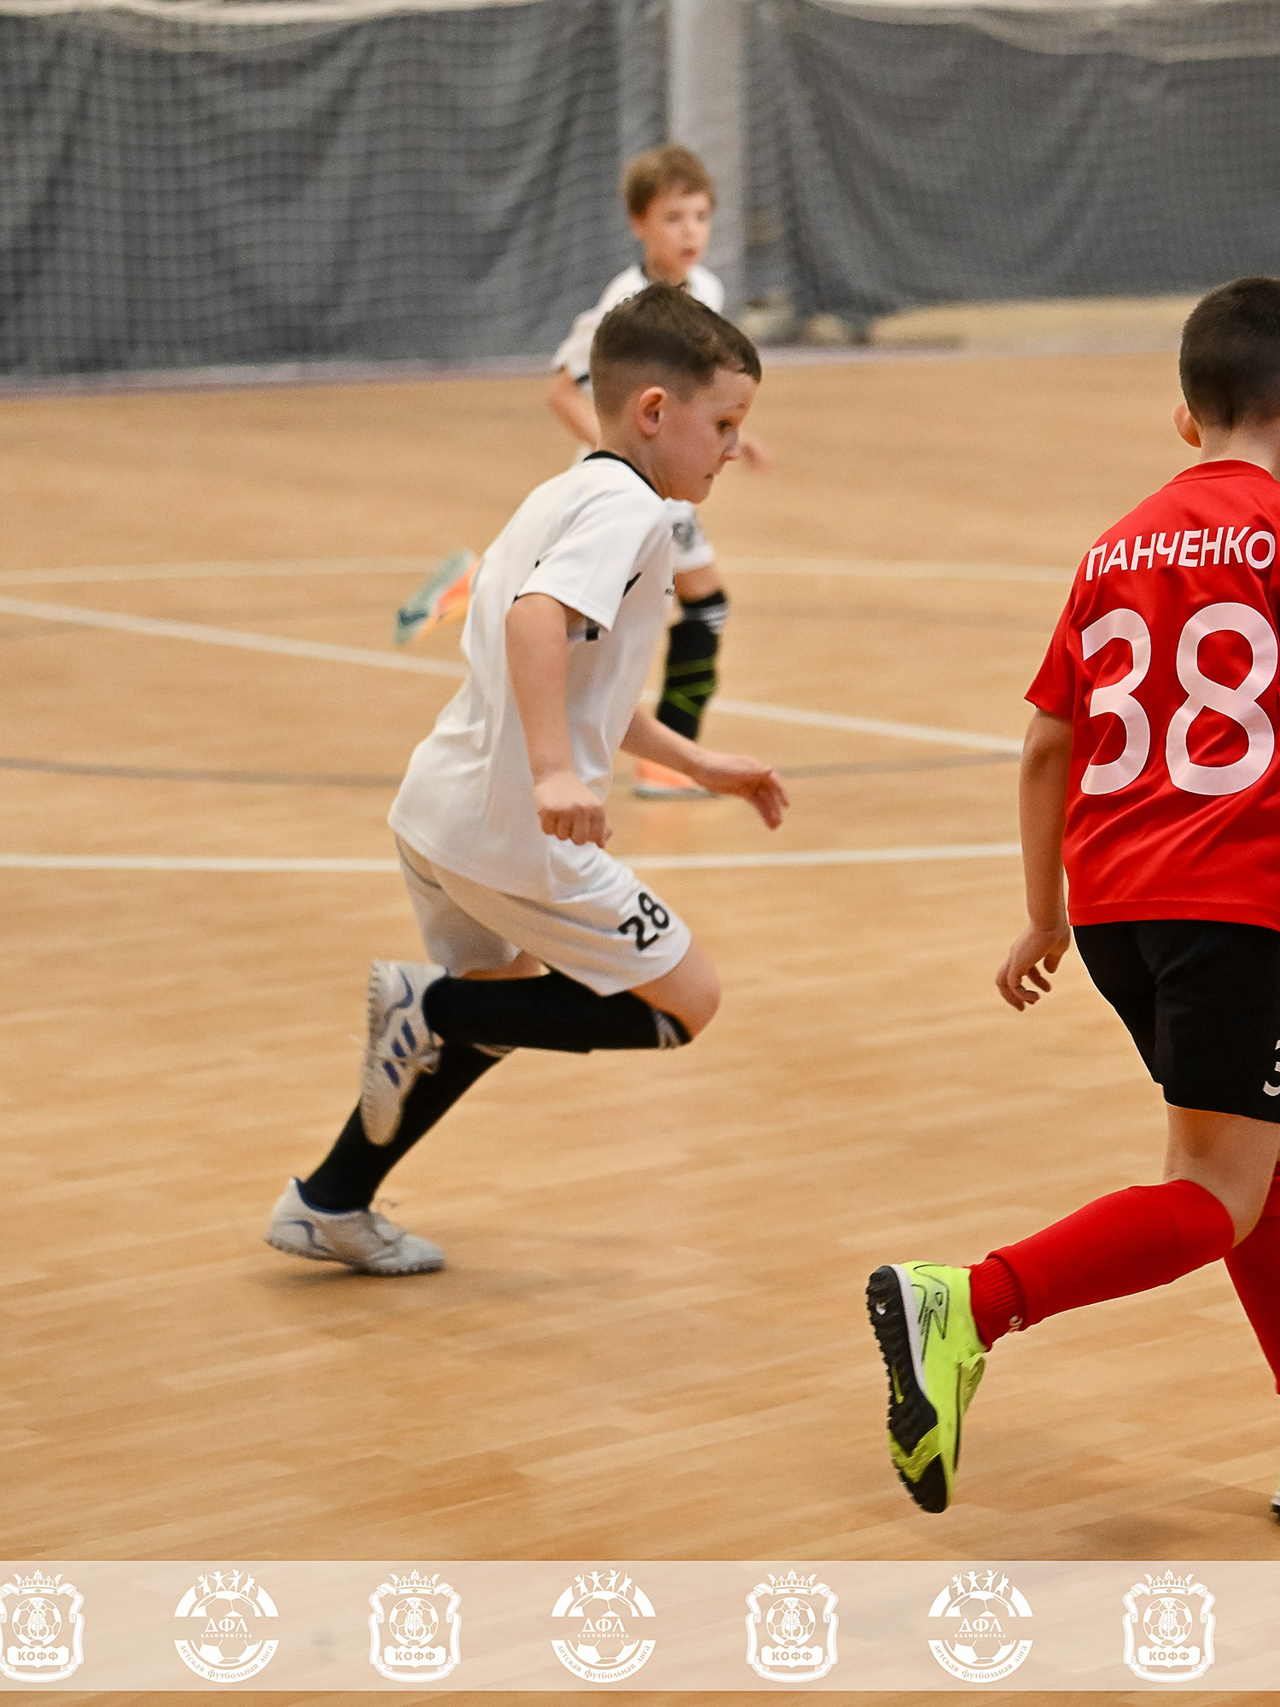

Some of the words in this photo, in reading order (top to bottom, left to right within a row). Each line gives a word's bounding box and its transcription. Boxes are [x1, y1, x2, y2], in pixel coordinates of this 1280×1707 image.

[1085, 526, 1276, 581] ПАНЧЕНКО
[1080, 602, 1279, 796] 38
[617, 891, 670, 951] 28
